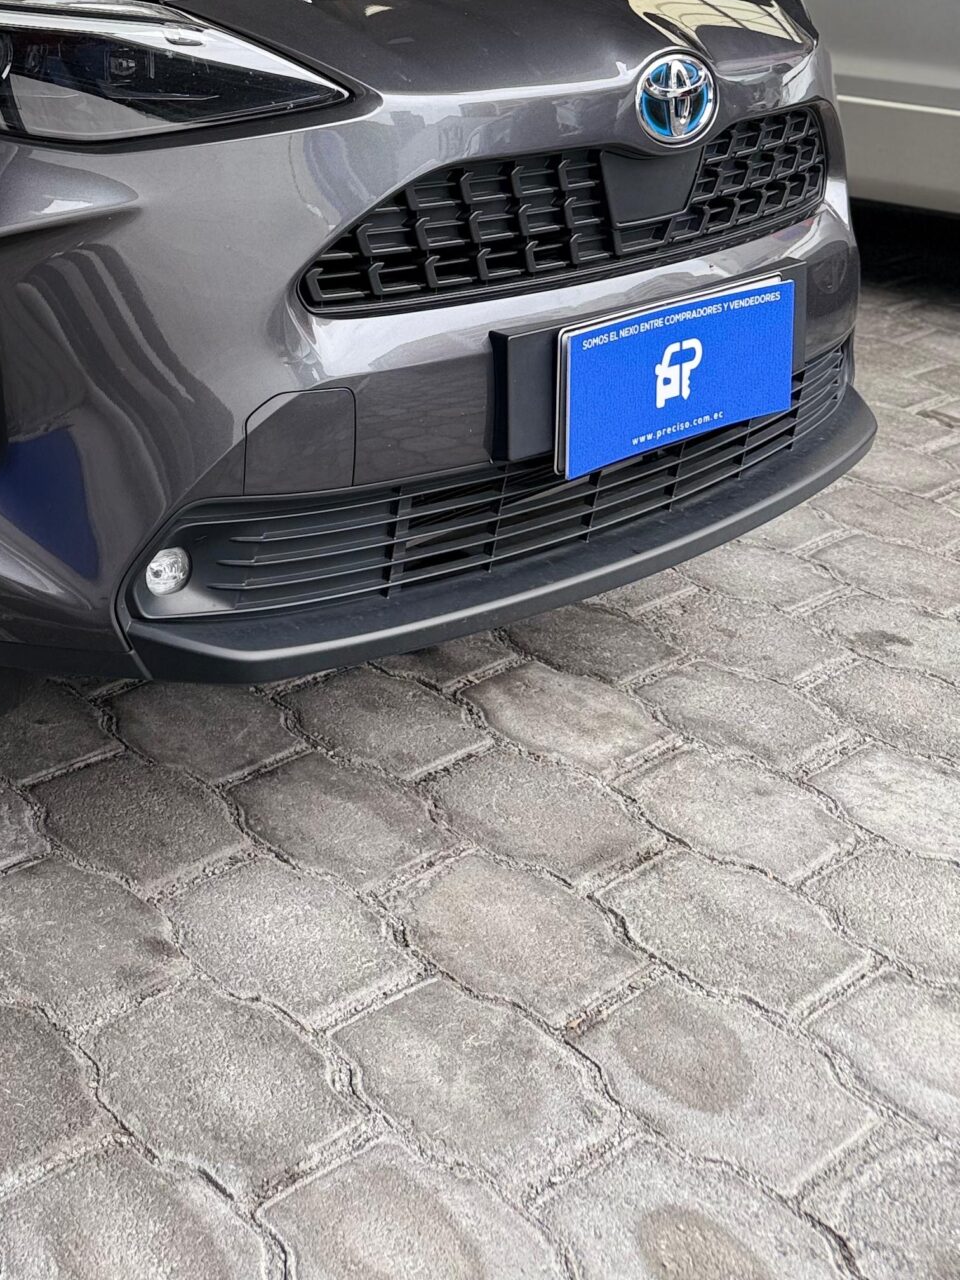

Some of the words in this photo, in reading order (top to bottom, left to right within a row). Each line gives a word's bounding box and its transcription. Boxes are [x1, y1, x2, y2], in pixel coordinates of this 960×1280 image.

[582, 333, 609, 351] SOMOS
[609, 330, 619, 341] EL
[619, 324, 640, 339] NEXO
[640, 317, 665, 333] ENTRE
[664, 303, 722, 325] COMPRADORES
[722, 301, 730, 312] Y
[729, 291, 781, 310] VENDEDORES
[631, 410, 724, 446] www.preciso.com.ec
